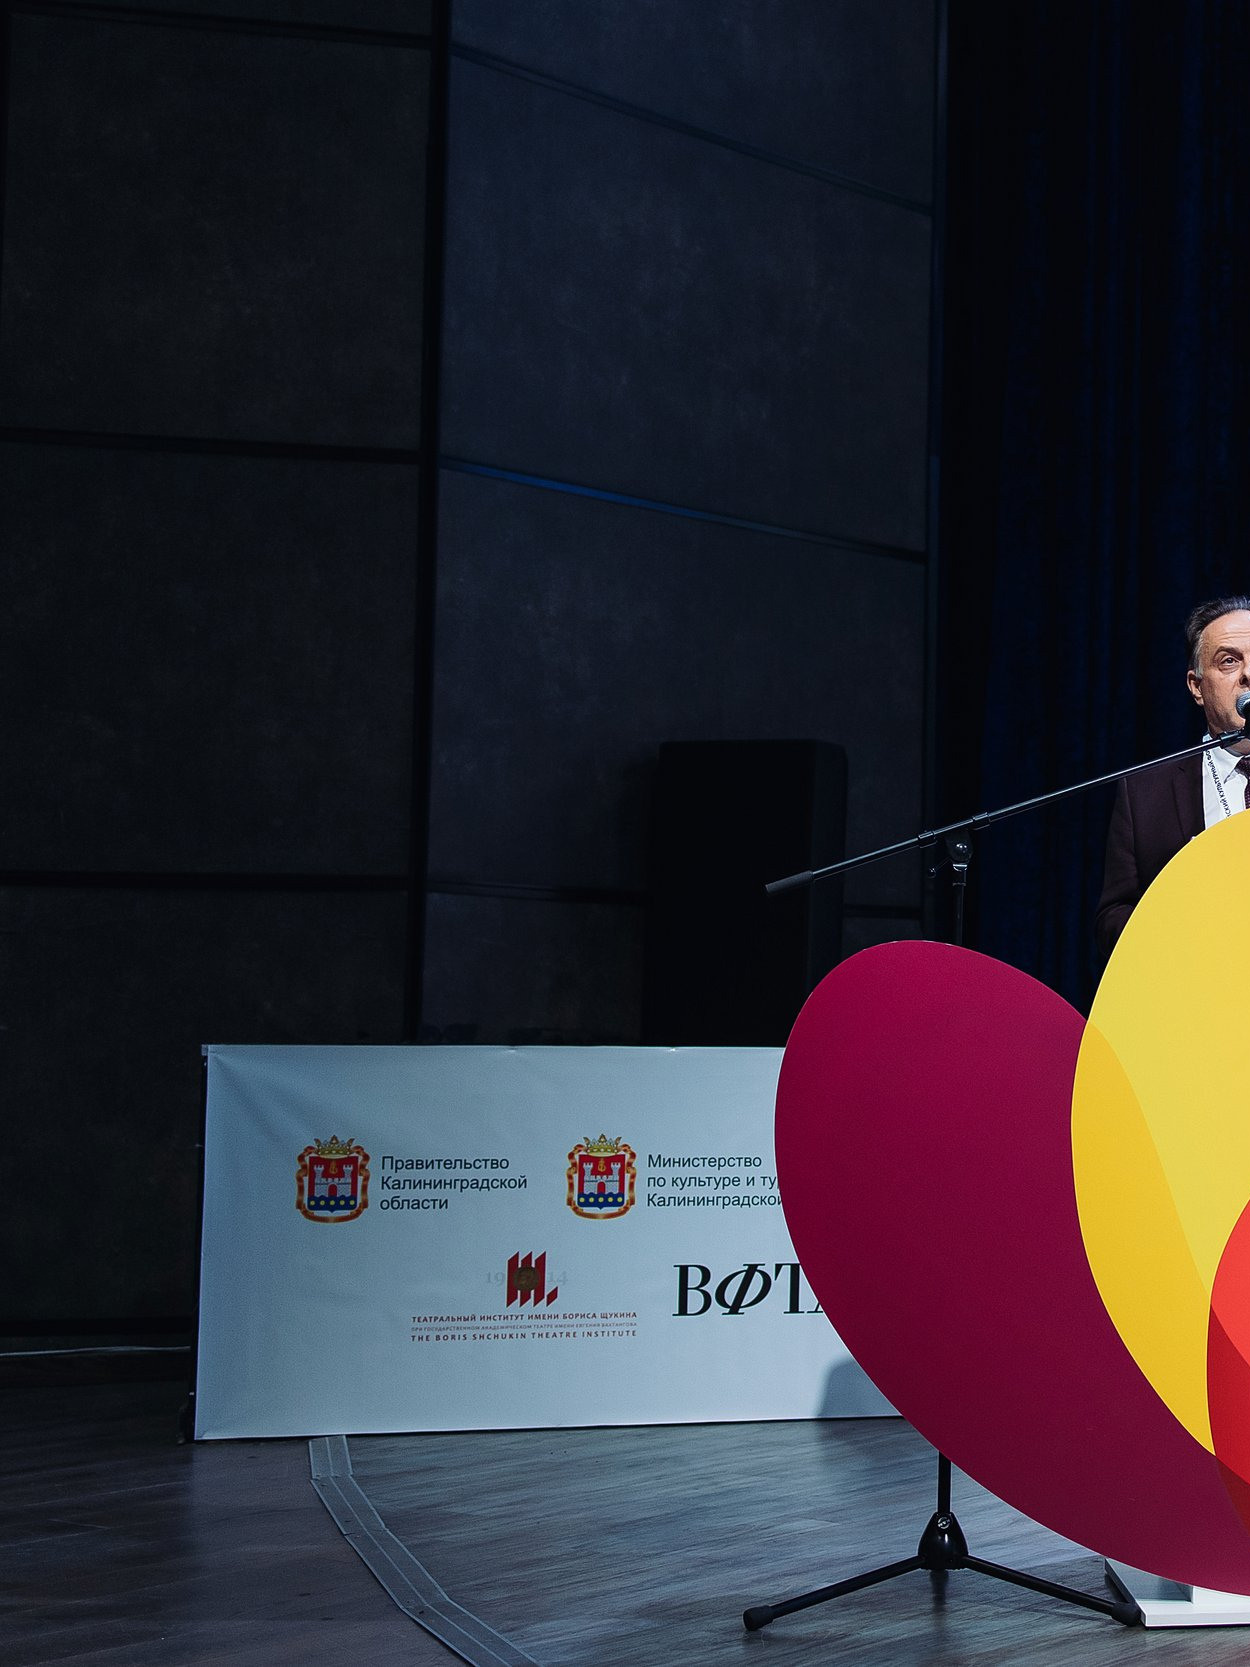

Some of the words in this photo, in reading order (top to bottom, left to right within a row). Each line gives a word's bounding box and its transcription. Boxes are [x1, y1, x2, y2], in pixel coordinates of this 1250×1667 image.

[381, 1156, 510, 1173] Правительство
[647, 1154, 762, 1170] Министерство
[380, 1175, 527, 1192] Калининградской
[647, 1177, 666, 1188] по
[671, 1176, 741, 1190] культуре
[746, 1176, 755, 1187] и
[760, 1176, 779, 1190] ту
[379, 1196, 449, 1210] области
[672, 1263, 823, 1316] ВФТ
[412, 1314, 476, 1323] ТЕАТРАЛЬНЫЙ
[480, 1314, 524, 1322] ИНСТИТУТ
[527, 1313, 559, 1321] ИМЕНИ
[562, 1312, 597, 1320] БОРИСА
[600, 1311, 637, 1320] ЩУКИНА
[411, 1334, 430, 1342] THE
[435, 1333, 468, 1341] BORIS
[472, 1332, 527, 1340] SHCHUKIN
[531, 1331, 577, 1339] THEATRE
[582, 1330, 637, 1338] INSTITUTE
